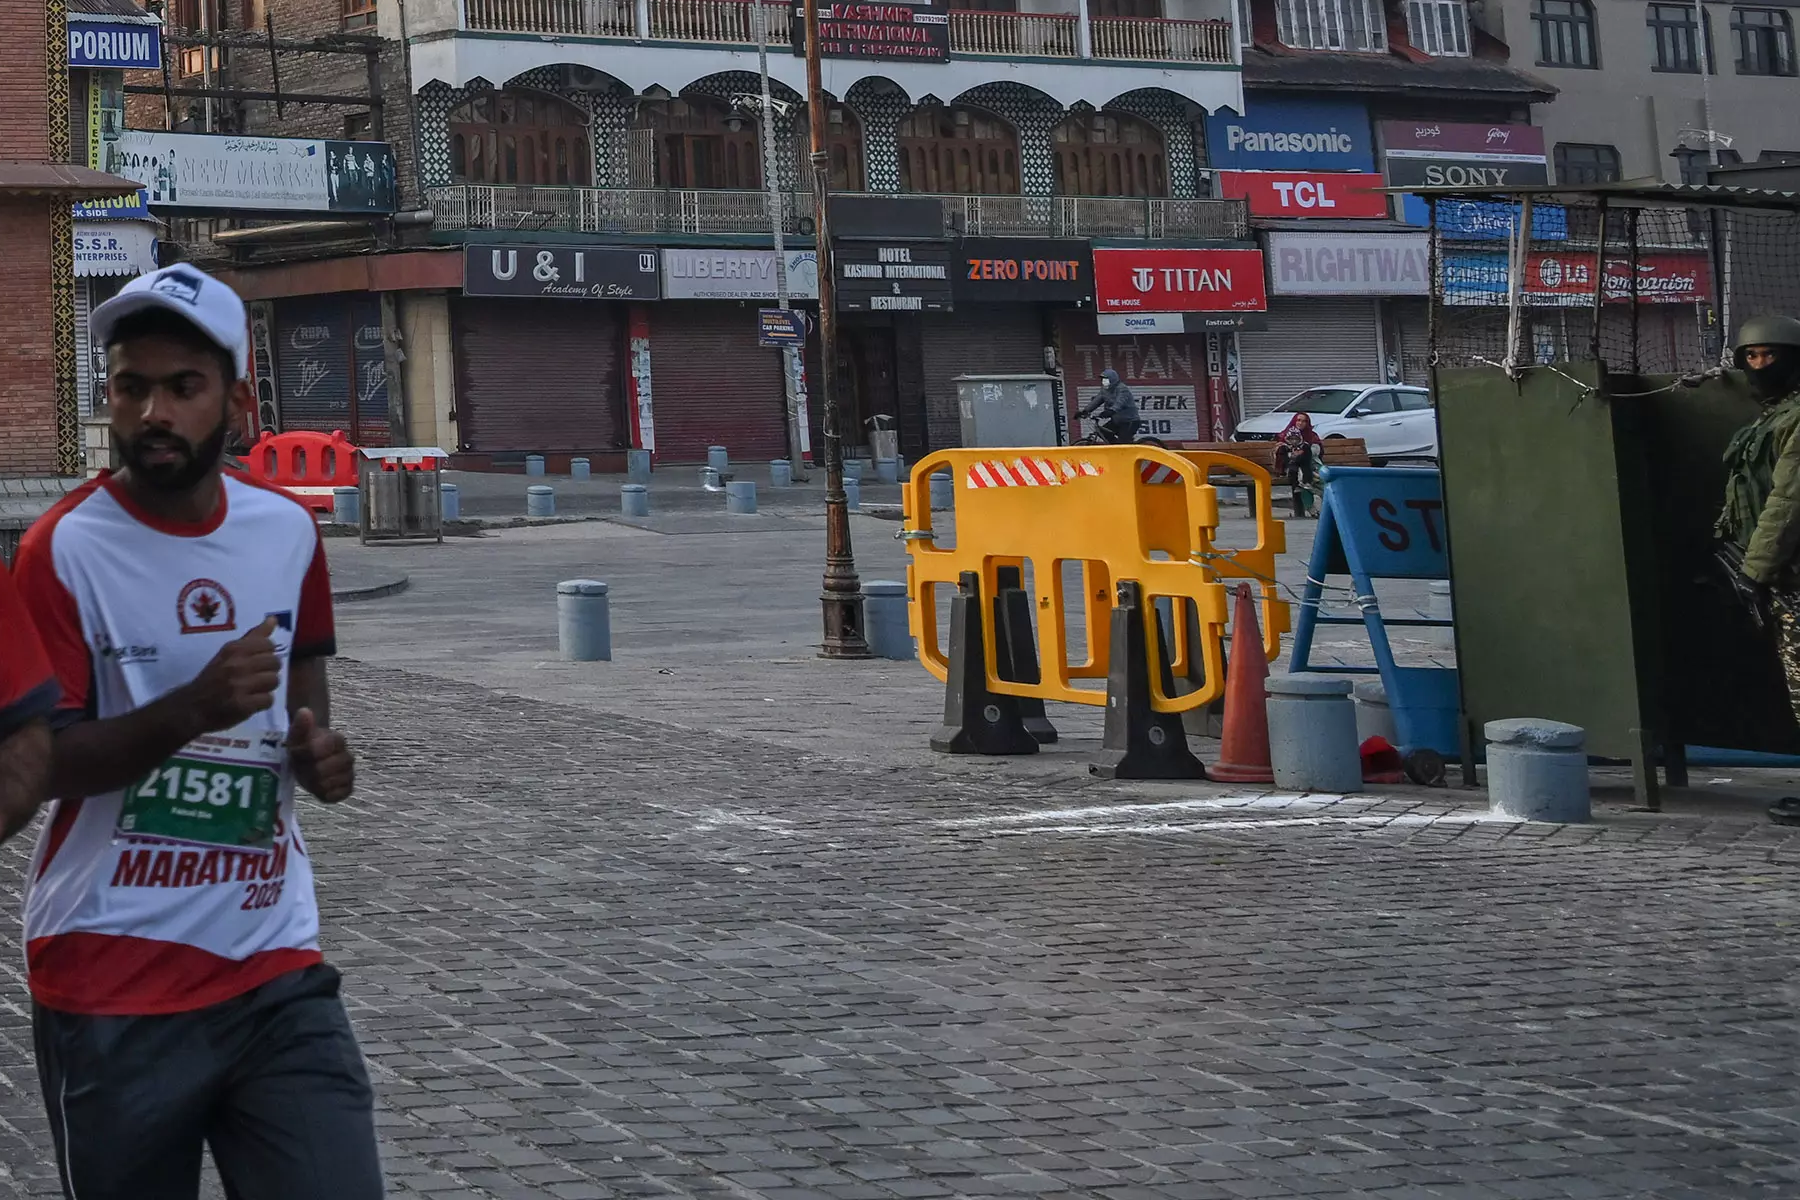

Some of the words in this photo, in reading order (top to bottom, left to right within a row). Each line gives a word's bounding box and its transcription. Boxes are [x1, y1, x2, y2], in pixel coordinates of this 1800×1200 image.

[831, 3, 914, 22] KASHMIR
[818, 22, 933, 43] NTERNATIONAL
[68, 30, 151, 61] PORIUM
[1226, 125, 1352, 154] Panasonic
[182, 157, 229, 185] NEW
[1425, 165, 1508, 186] SONY
[1272, 181, 1336, 208] TCL
[72, 209, 84, 217] CK
[86, 209, 108, 217] SIDE
[74, 238, 123, 250] S.S.R.
[491, 249, 518, 281] U
[532, 250, 561, 282] &
[574, 251, 585, 282] I
[877, 247, 912, 263] HOTEL
[671, 256, 776, 280] LIBERTY
[843, 264, 883, 279] KASHMIR
[885, 264, 947, 280] INTERNATIONAL
[967, 258, 1019, 281] ZERO
[1021, 259, 1080, 281] POINT
[1446, 266, 1509, 284] SAMSUN
[1565, 264, 1589, 283] LG
[541, 283, 588, 297] Academy
[590, 283, 603, 297] Of
[606, 283, 633, 297] Style
[892, 282, 901, 294] &
[1159, 268, 1233, 293] TITAN
[870, 296, 923, 310] RESTAURANT
[1121, 299, 1141, 307] HOUSE
[300, 326, 330, 339] RUPA
[773, 324, 795, 332] PARKING
[1125, 318, 1156, 327] SONATA
[1205, 318, 1235, 326] fastrack
[1075, 344, 1193, 381] TITAN
[1207, 332, 1221, 373] ASIO
[1211, 376, 1226, 443] TITAN
[1368, 497, 1442, 554] ST
[137, 766, 254, 809] 21581
[110, 839, 288, 890] MARATHON
